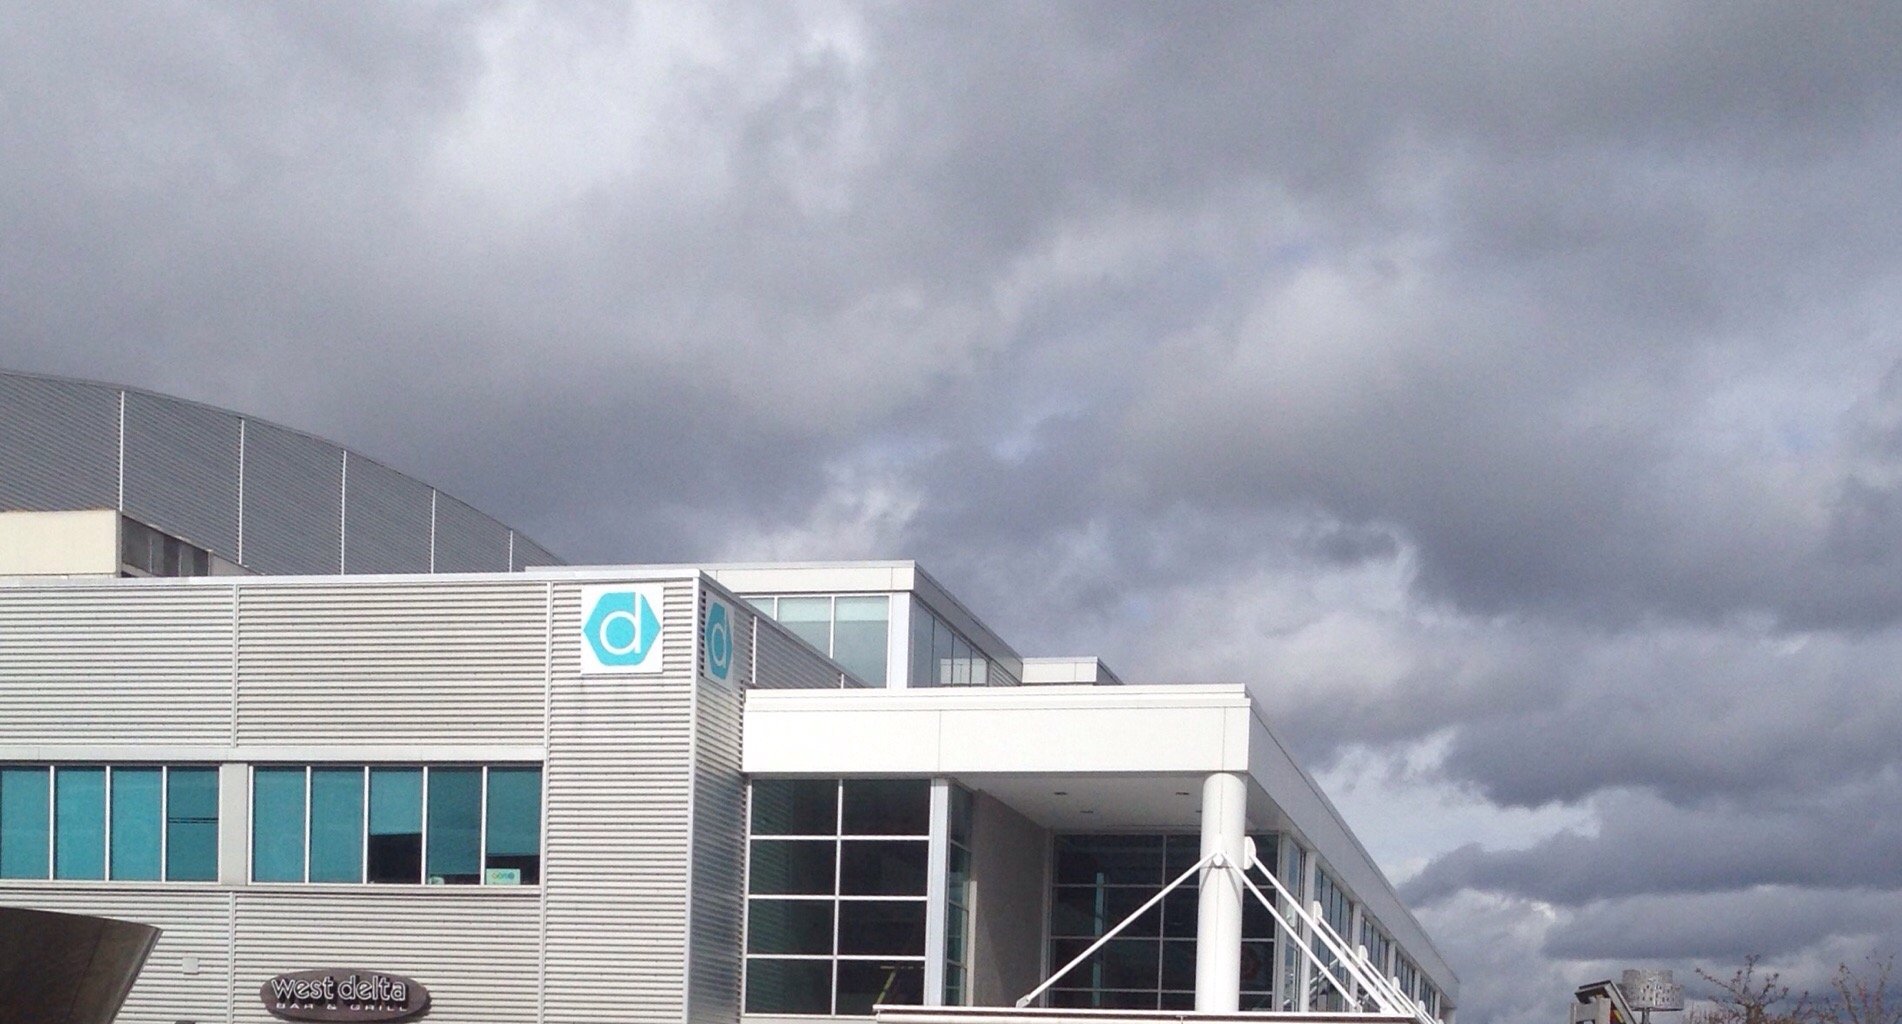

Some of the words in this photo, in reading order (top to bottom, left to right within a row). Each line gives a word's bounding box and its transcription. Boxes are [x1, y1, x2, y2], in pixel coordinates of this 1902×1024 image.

[599, 592, 642, 655] d
[711, 606, 727, 669] d
[271, 976, 334, 1000] west
[337, 975, 406, 1001] delta
[276, 1002, 314, 1010] BAR
[326, 1003, 337, 1011] &
[350, 1003, 408, 1012] GRILL
